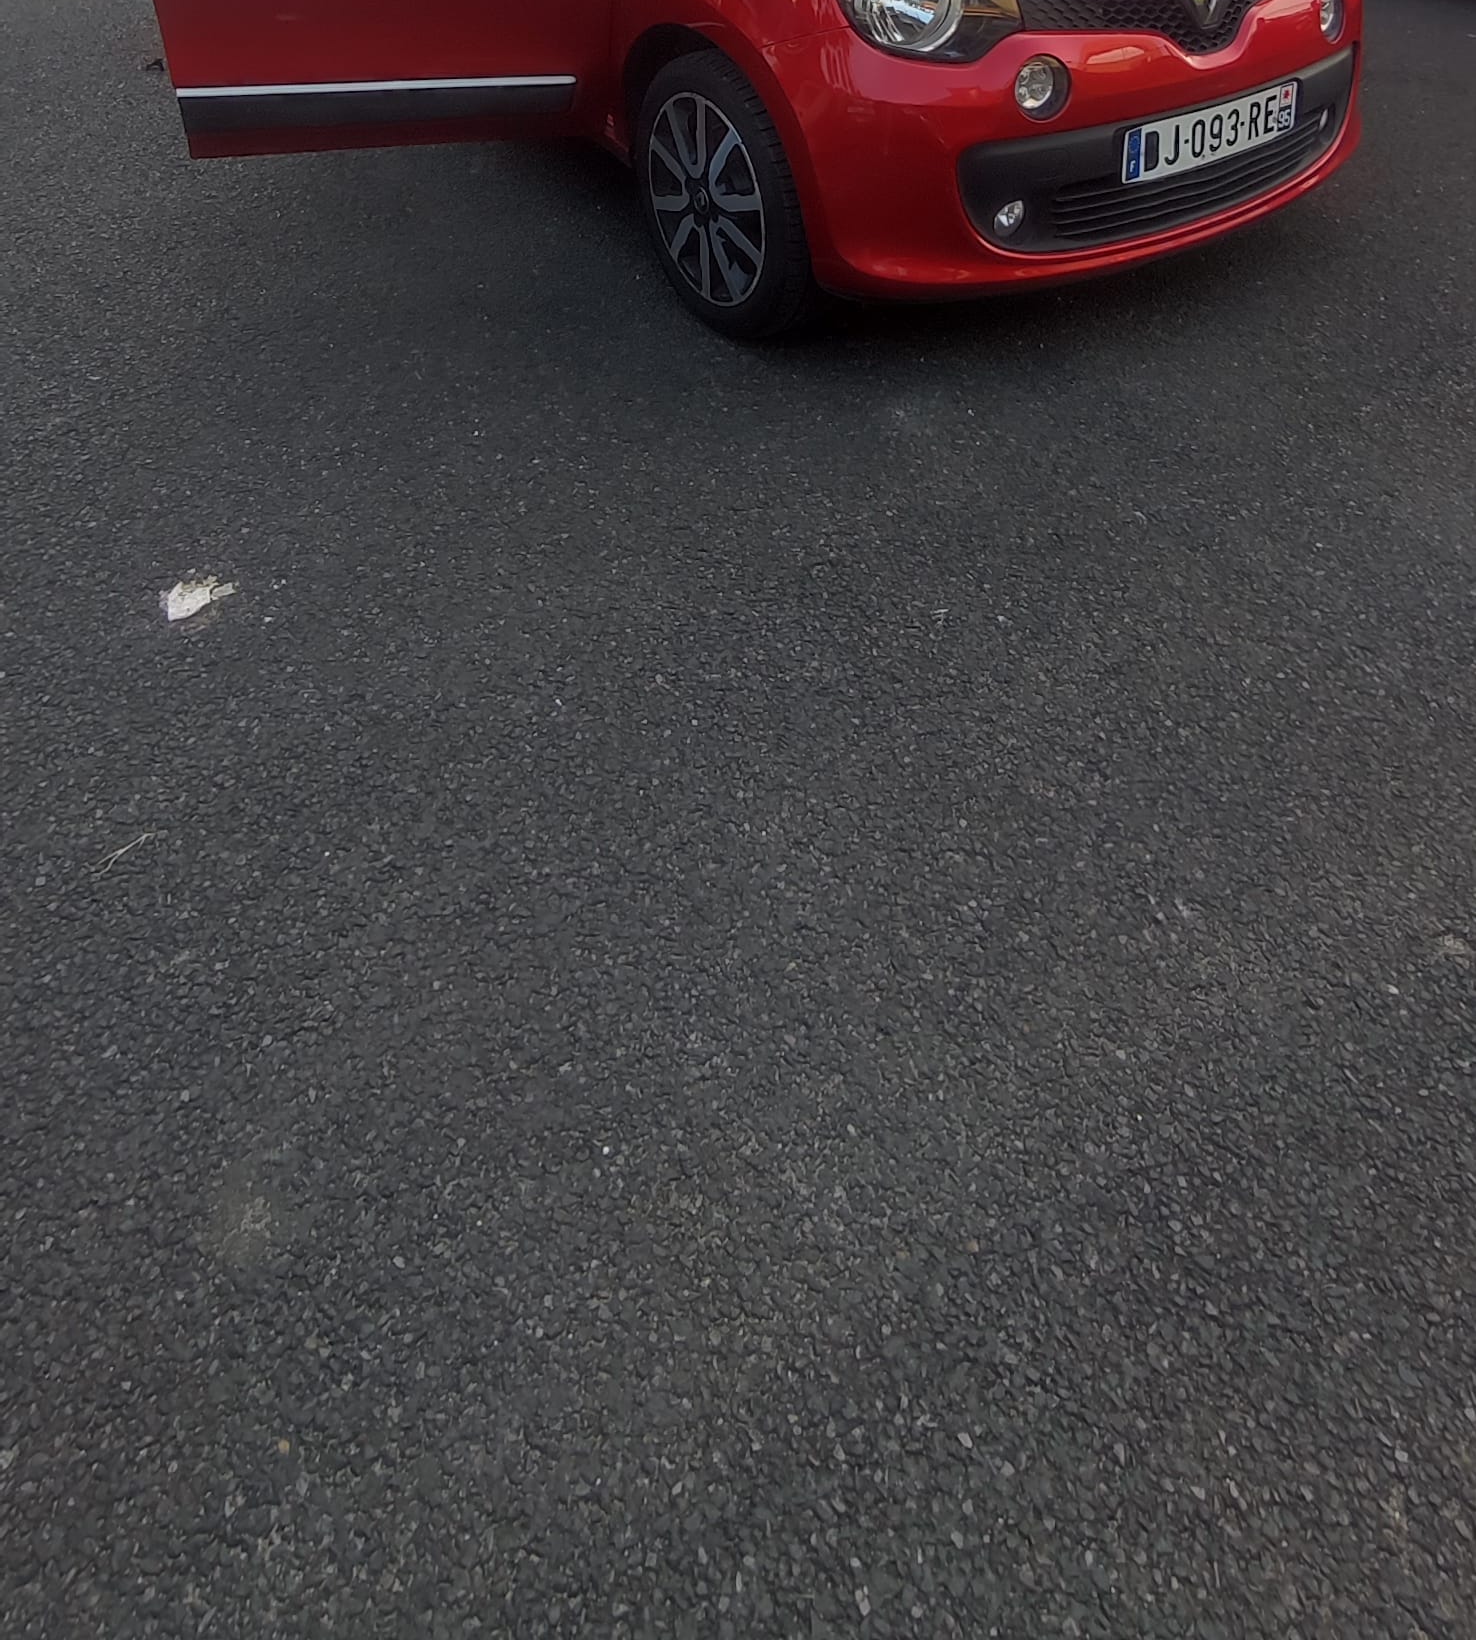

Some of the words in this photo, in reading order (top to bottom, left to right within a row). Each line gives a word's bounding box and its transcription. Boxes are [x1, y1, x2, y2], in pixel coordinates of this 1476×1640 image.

[1278, 109, 1291, 129] 95
[1144, 95, 1277, 172] DJ-093-RE
[1129, 159, 1136, 173] F
